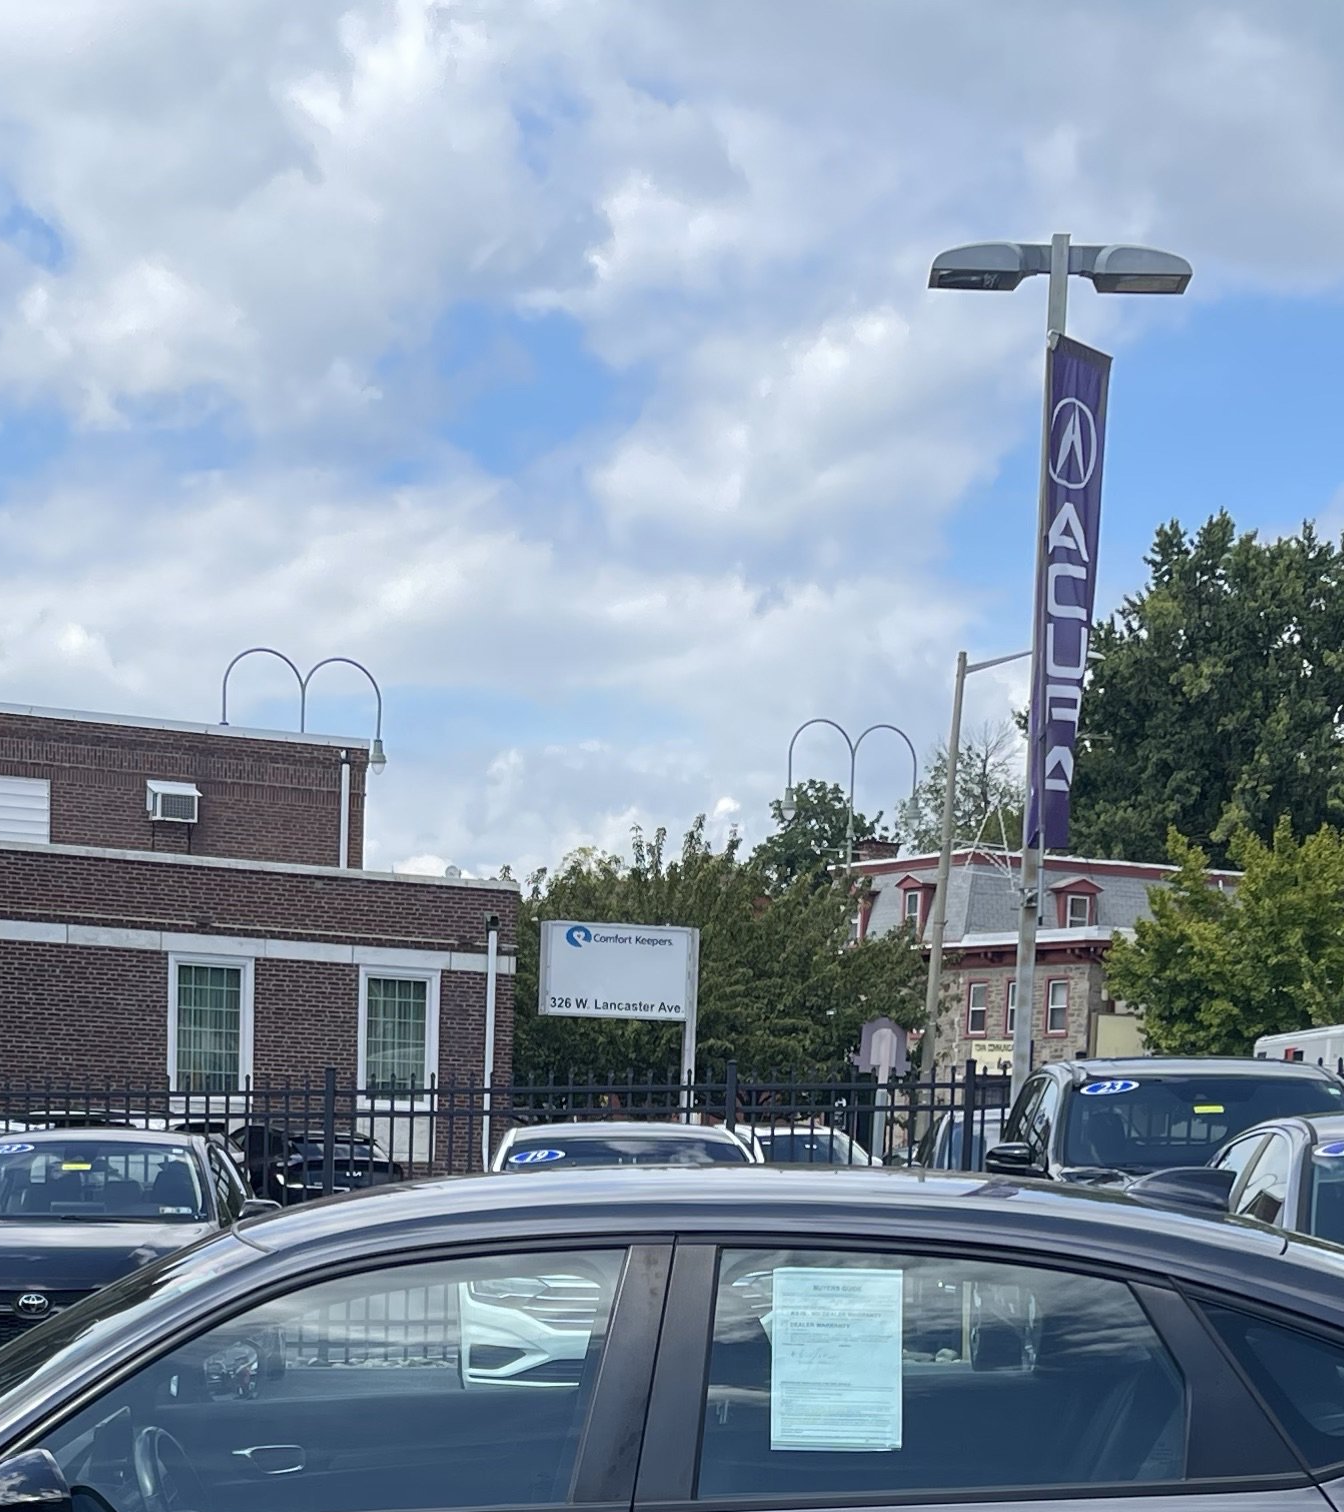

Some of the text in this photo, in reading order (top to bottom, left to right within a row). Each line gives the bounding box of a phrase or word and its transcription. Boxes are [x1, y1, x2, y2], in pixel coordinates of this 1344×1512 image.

[1044, 501, 1090, 792] ACURA
[593, 933, 673, 948] Comfort Keepers
[550, 997, 685, 1014] 326 W. Lancaster Ave.
[1097, 1081, 1123, 1094] 23
[525, 1150, 549, 1162] 19
